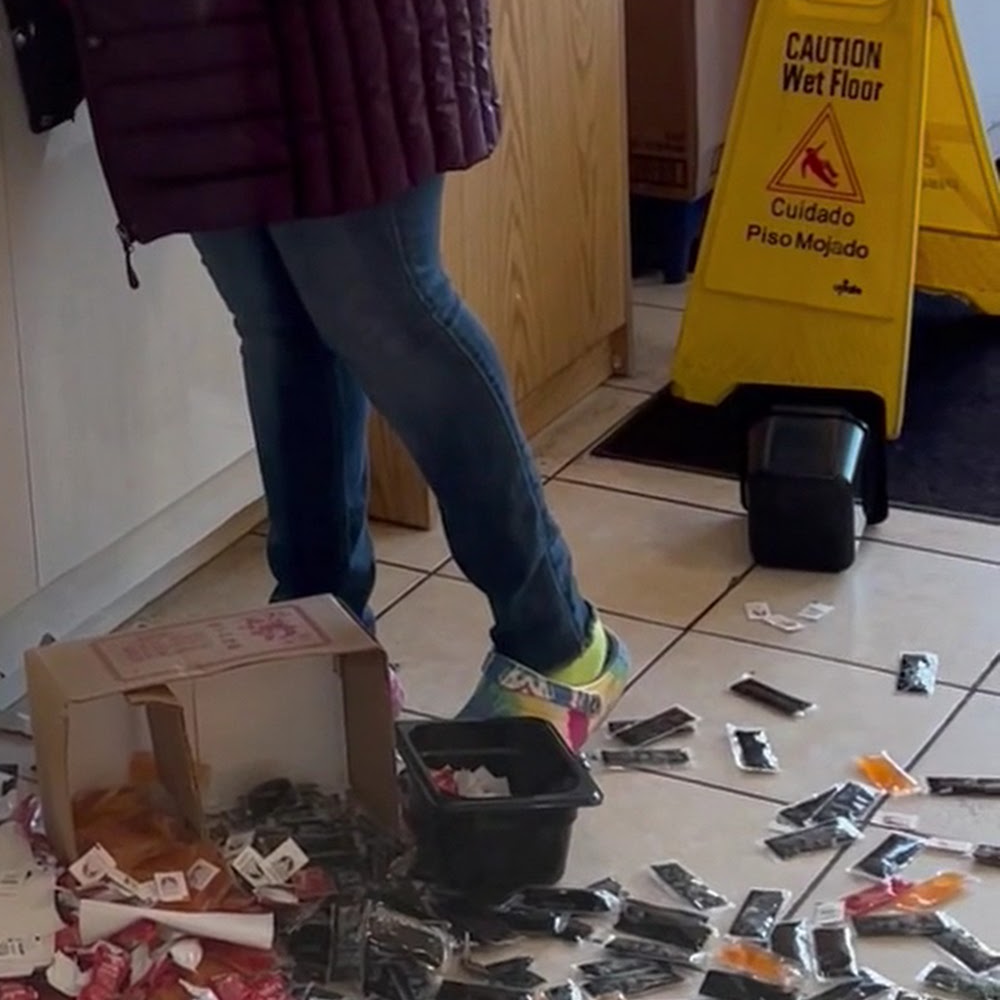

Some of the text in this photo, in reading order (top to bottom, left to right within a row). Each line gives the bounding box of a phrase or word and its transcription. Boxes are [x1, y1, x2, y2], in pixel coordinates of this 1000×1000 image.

[786, 32, 883, 69] CAUTION
[783, 63, 885, 101] Wet Floor
[771, 197, 855, 227] Cuidado
[746, 224, 869, 259] Piso Mojado
